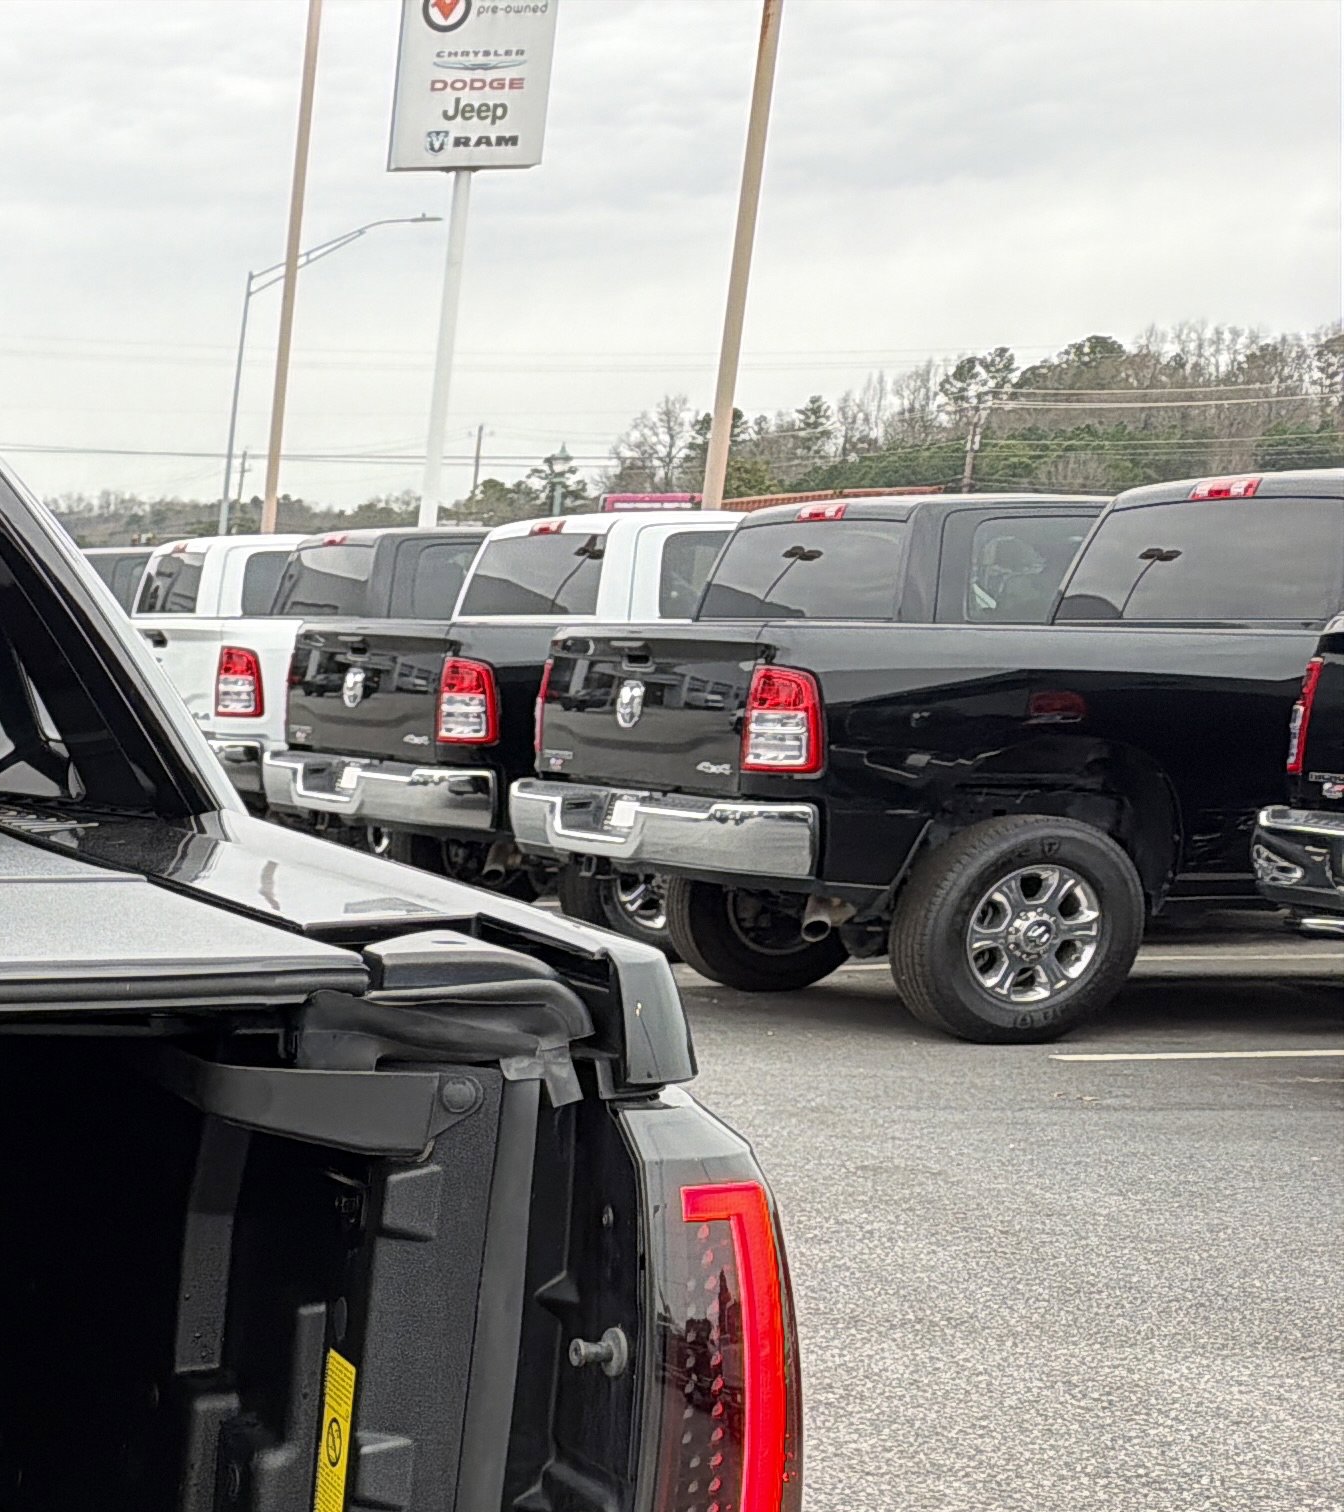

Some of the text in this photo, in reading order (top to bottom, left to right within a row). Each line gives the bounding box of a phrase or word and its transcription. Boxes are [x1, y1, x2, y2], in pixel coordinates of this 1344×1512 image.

[477, 1, 548, 17] pre-owned
[435, 48, 526, 59] CHRYSLER
[430, 77, 526, 92] DODGE
[442, 97, 508, 126] Jeep
[452, 134, 520, 148] RAM
